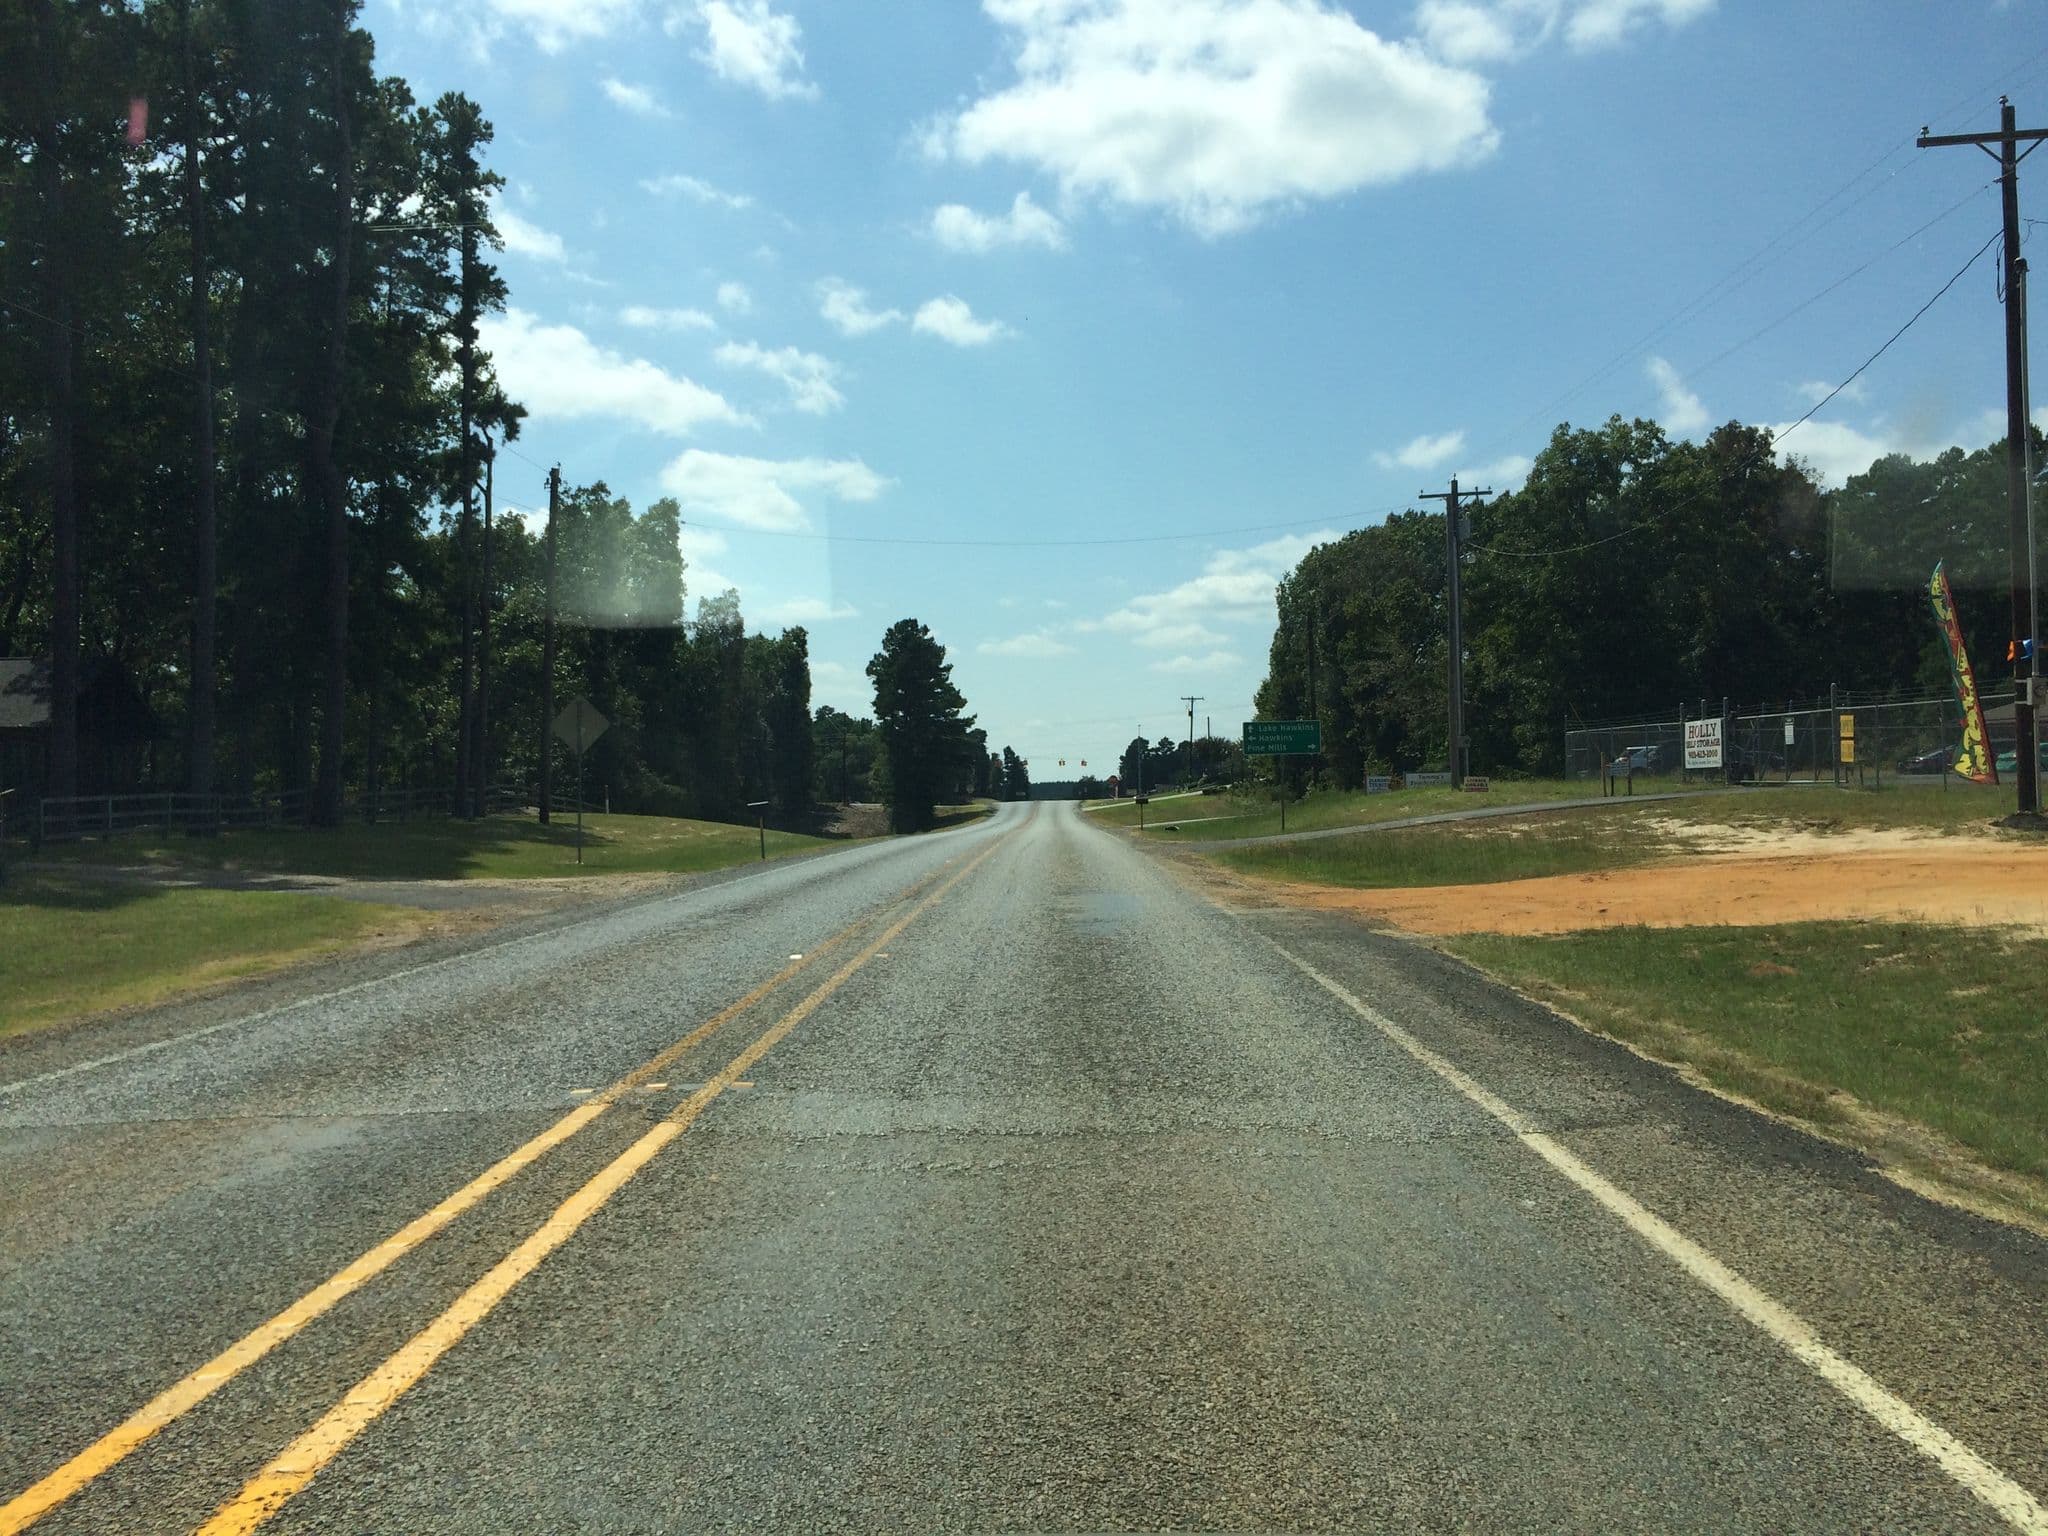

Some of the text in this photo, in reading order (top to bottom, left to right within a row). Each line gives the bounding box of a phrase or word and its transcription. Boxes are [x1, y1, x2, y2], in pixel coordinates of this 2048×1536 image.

[1259, 723, 1314, 732] Lake Hawkins
[1688, 723, 1717, 739] HOLLY
[1248, 744, 1288, 752] Pine Mills
